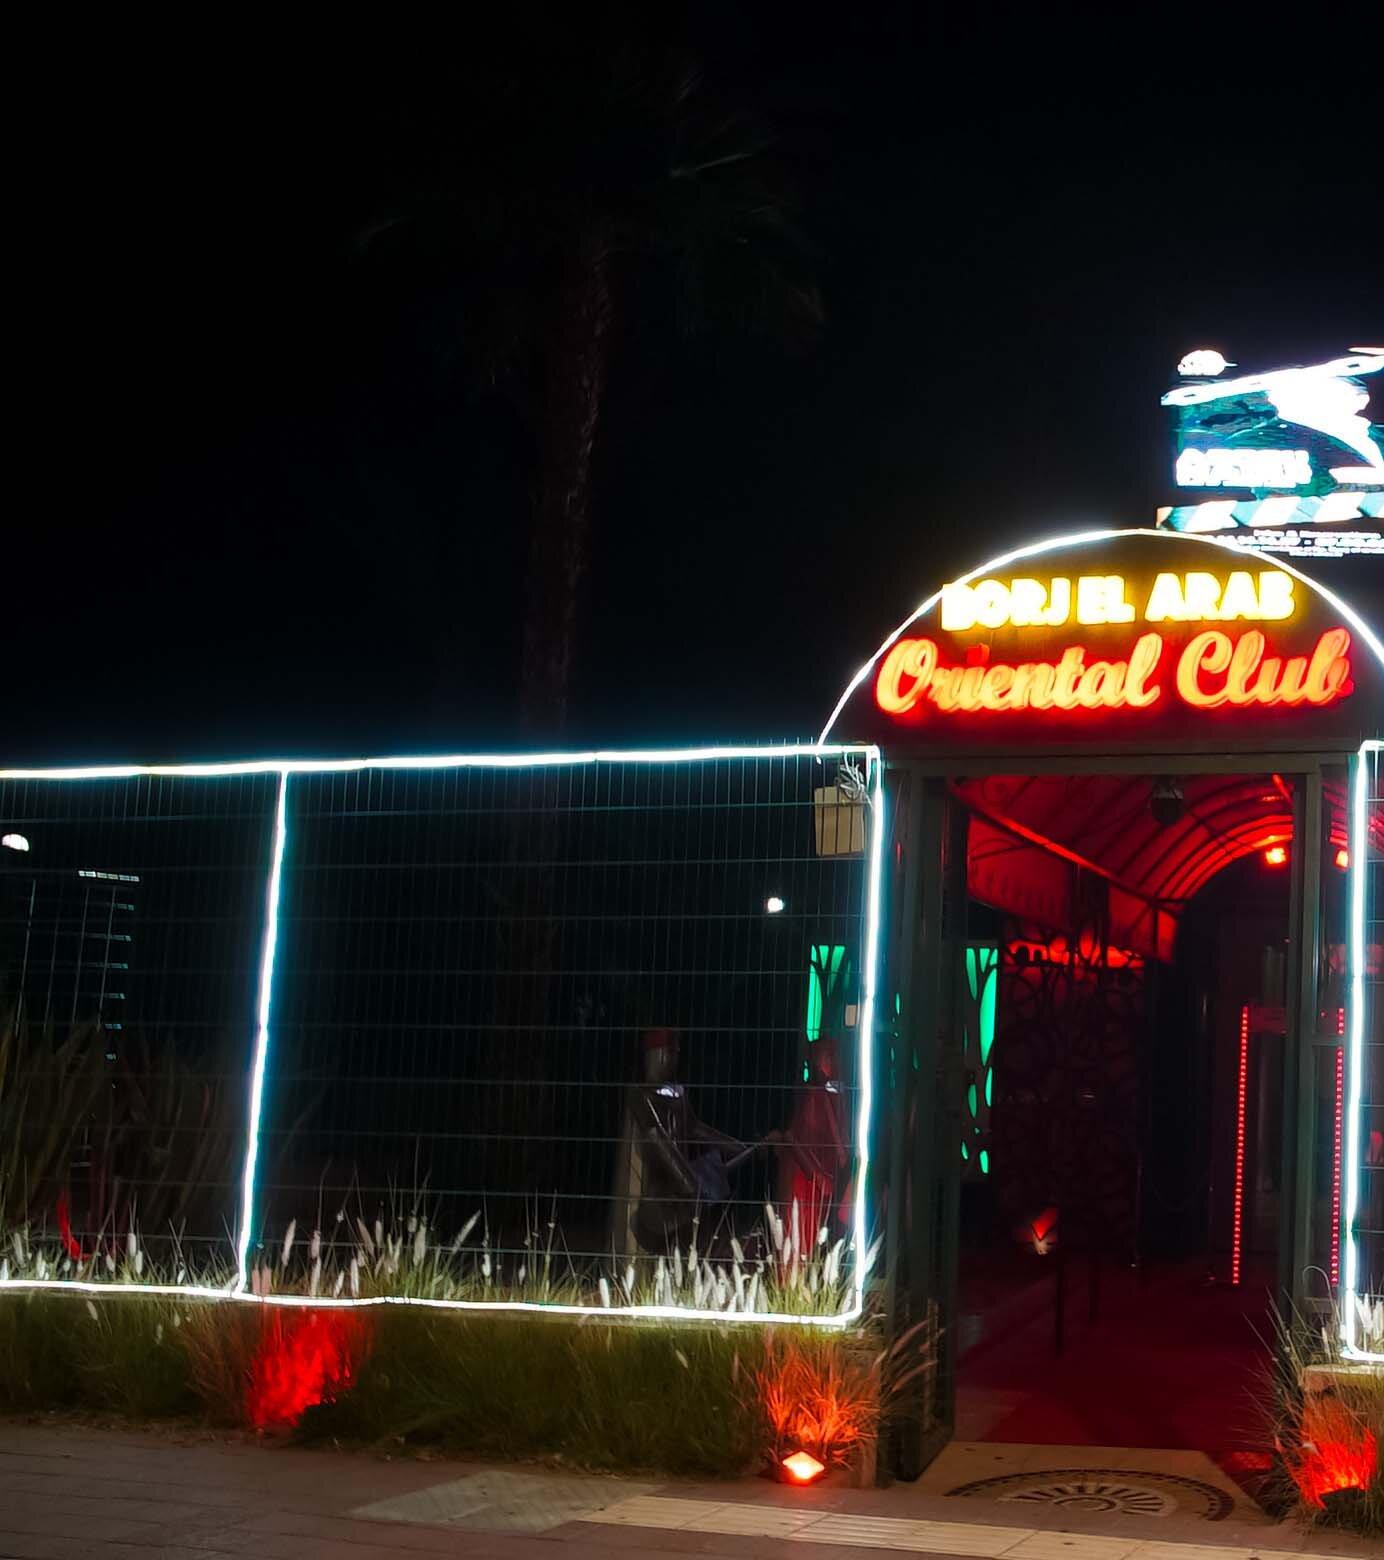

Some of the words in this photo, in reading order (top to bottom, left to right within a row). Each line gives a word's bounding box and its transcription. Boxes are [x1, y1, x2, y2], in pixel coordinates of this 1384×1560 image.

[1145, 571, 1295, 622] ARAB
[876, 632, 1162, 714] Oriental
[1177, 628, 1354, 707] Club
